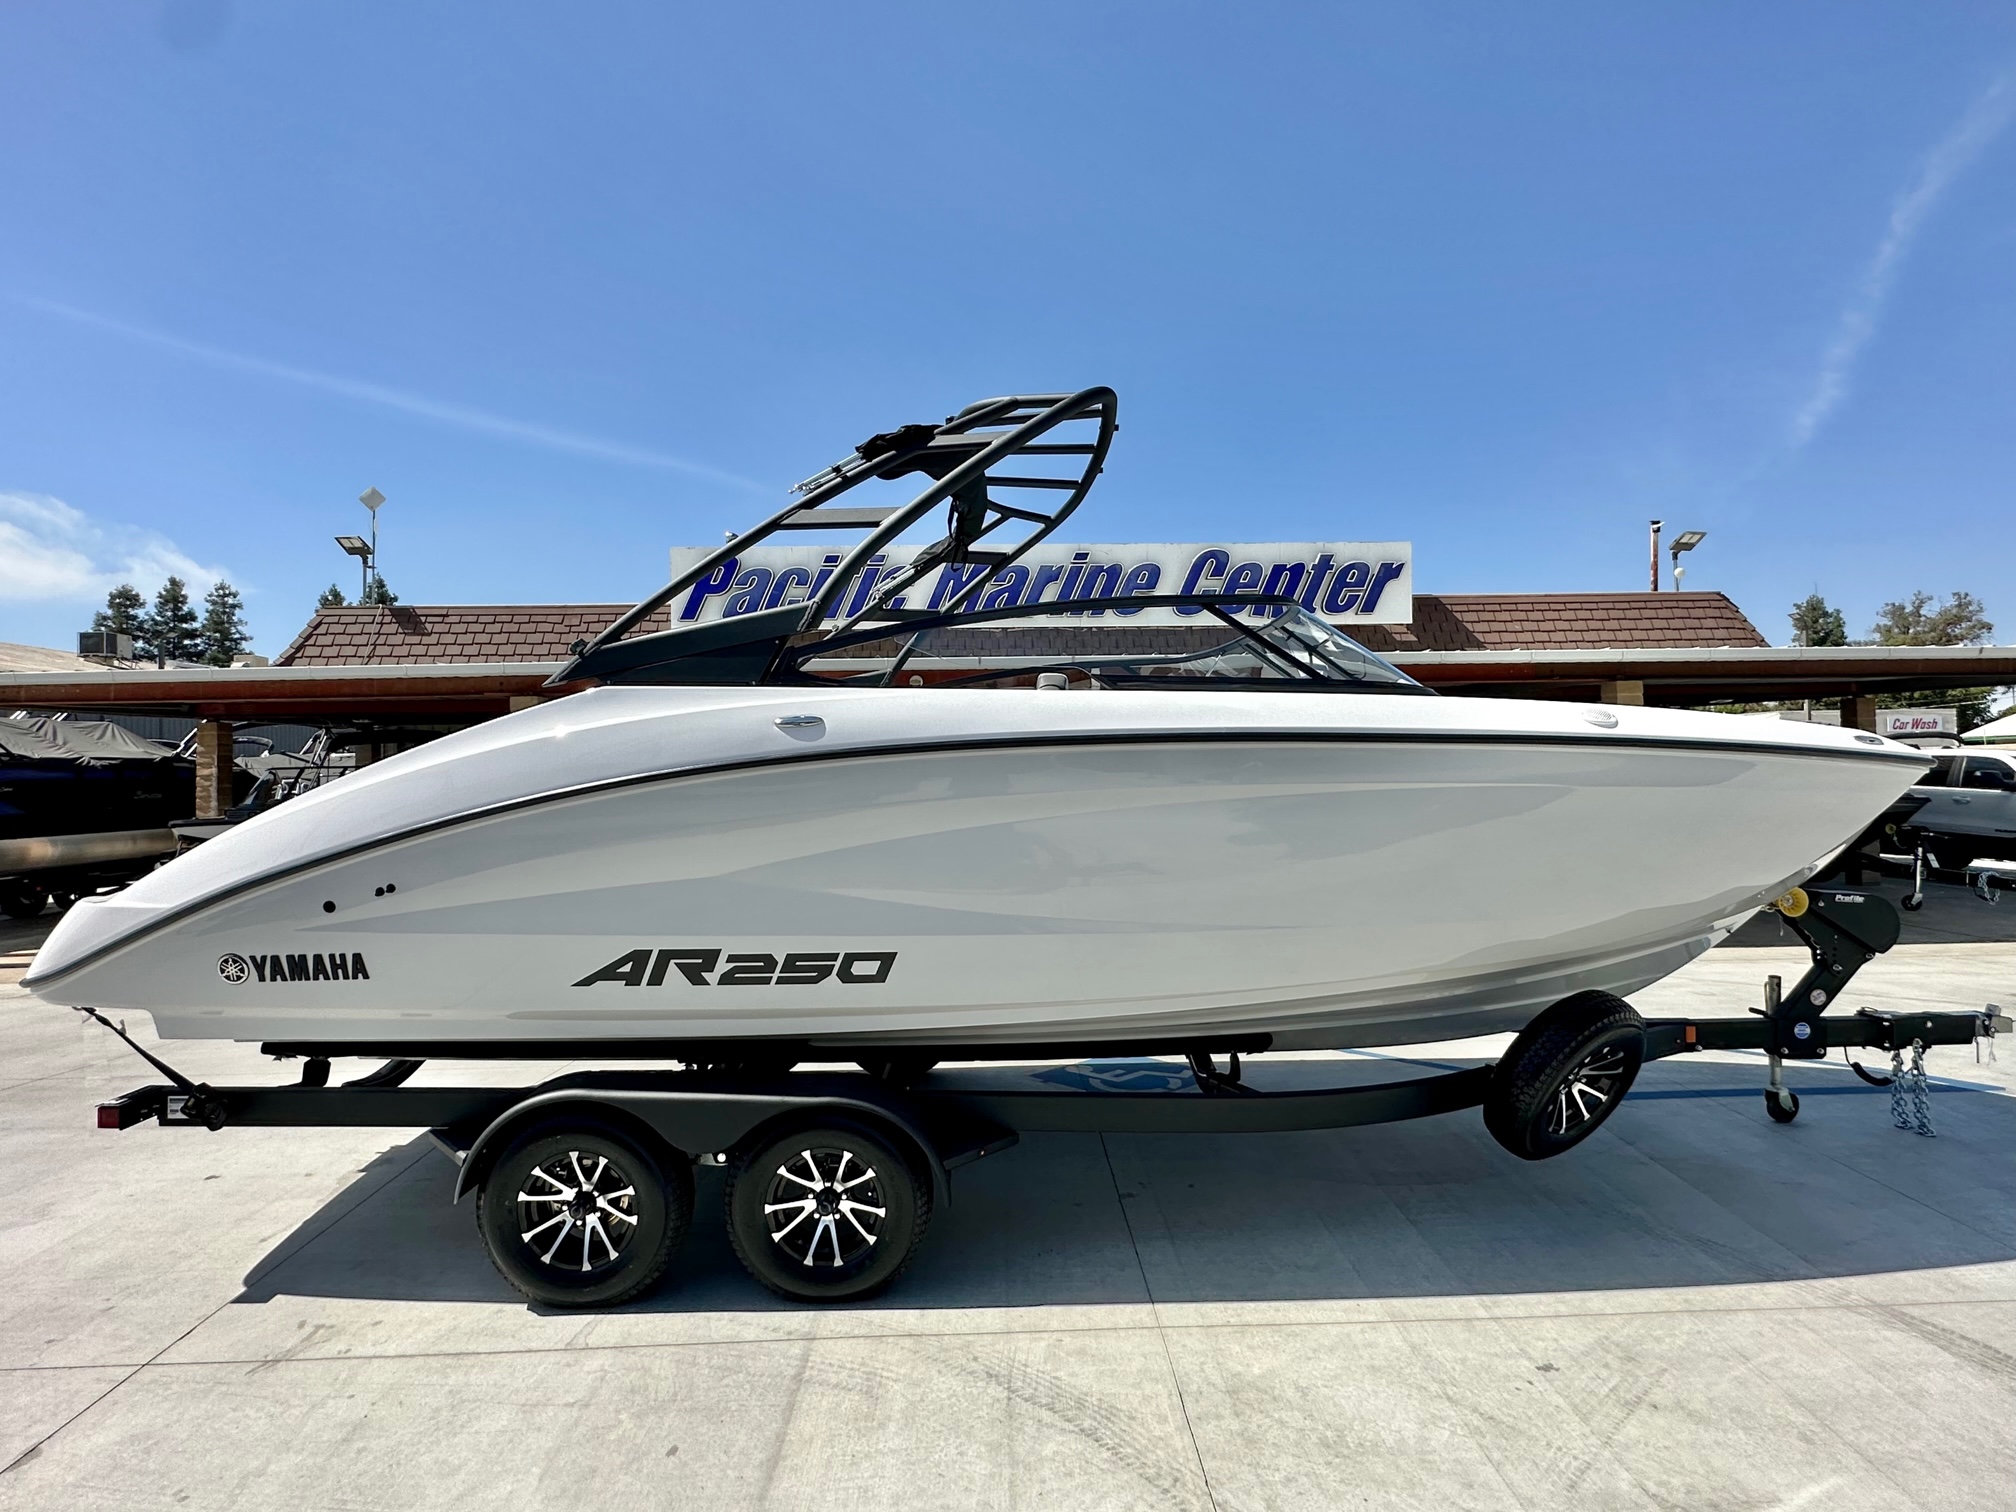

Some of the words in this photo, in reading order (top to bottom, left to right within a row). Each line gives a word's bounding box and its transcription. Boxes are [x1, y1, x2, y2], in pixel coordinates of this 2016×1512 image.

[925, 551, 1162, 617] Marine
[1173, 547, 1406, 618] Center
[1892, 717, 1909, 730] Car
[1911, 717, 1938, 730] Wash
[249, 952, 370, 982] YAMAHA
[570, 948, 899, 987] AR250
